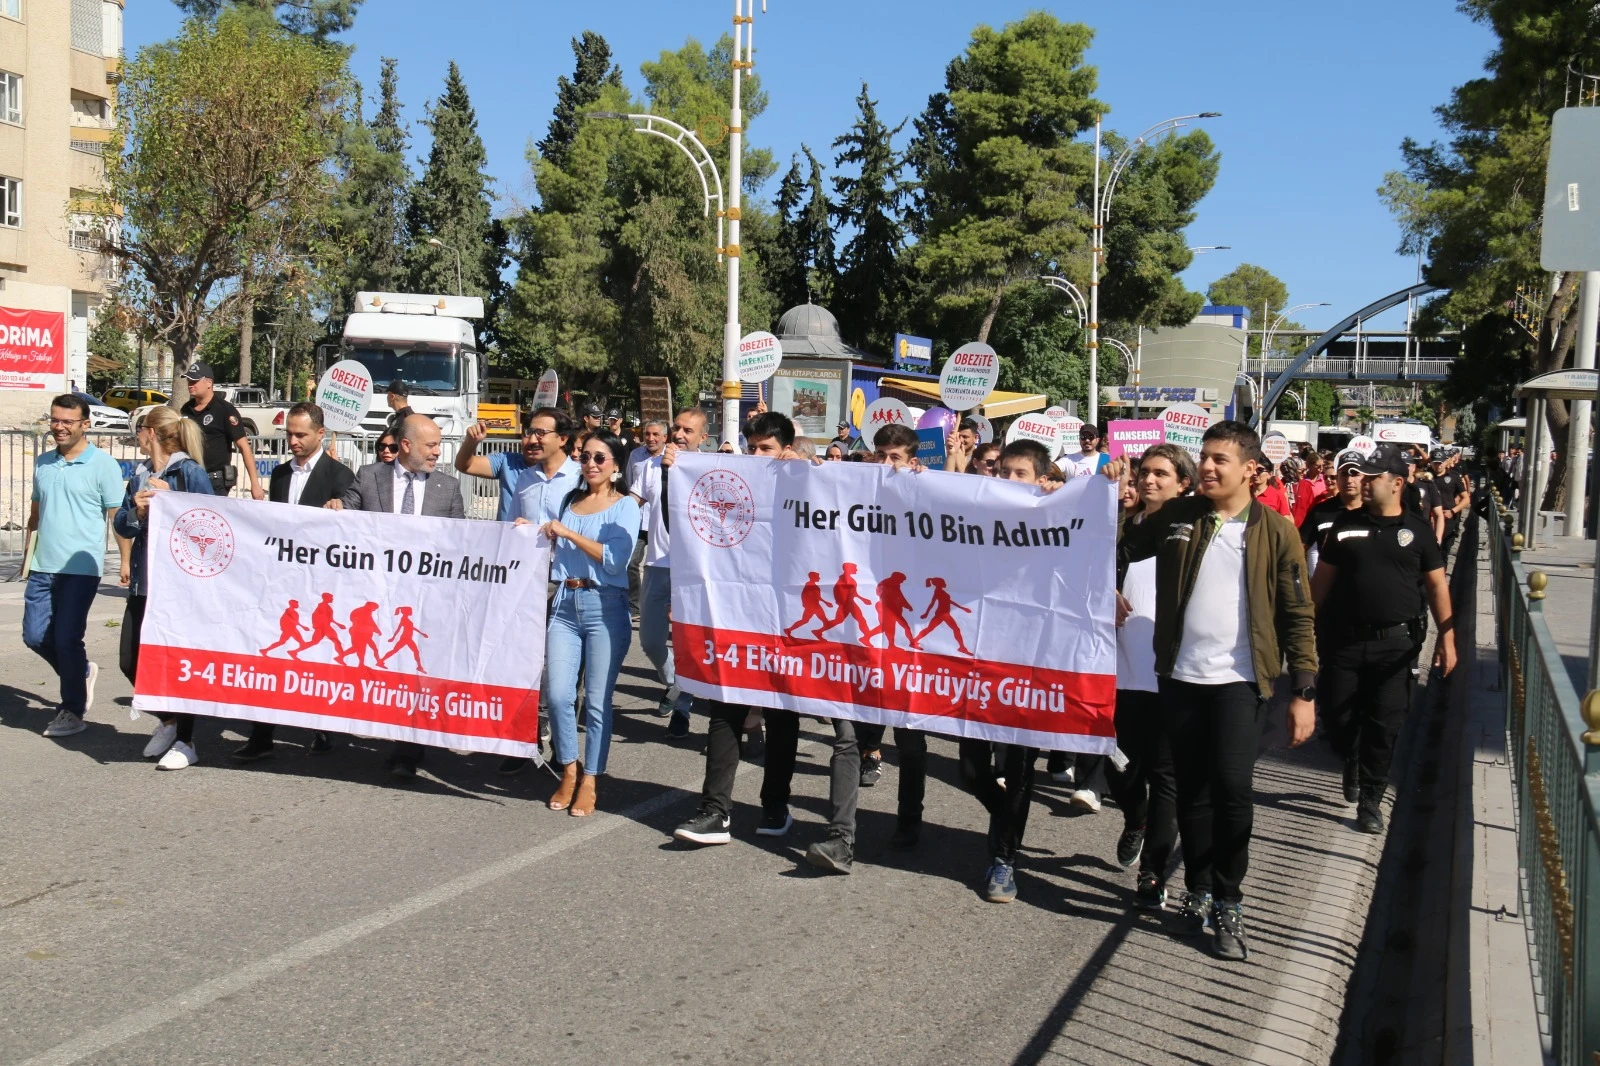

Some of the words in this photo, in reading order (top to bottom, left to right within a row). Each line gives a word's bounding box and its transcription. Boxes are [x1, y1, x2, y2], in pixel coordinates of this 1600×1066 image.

[739, 337, 774, 352] OBEZİTE
[738, 353, 775, 368] HAREKETE
[954, 353, 994, 367] OBEZİTE
[331, 367, 369, 392] OBEZİTE
[792, 369, 837, 379] KİTAPÇILARDA
[946, 374, 989, 387] HAREKETE
[321, 388, 361, 412] HAREKETE
[1165, 411, 1209, 428] OBEZİTE
[1165, 422, 1180, 430] SAĞLIK
[1018, 420, 1057, 438] OBEZİTE
[1113, 428, 1161, 441] KANSERSİZ
[1165, 431, 1204, 445] AREKETE
[847, 503, 897, 536] Gün
[904, 511, 934, 540] 10
[940, 513, 985, 546] Bin
[325, 543, 375, 571] Gün
[383, 549, 413, 574] 10
[417, 551, 452, 579] Bin
[702, 639, 739, 668] 3-4
[745, 644, 803, 678] Ekim
[809, 651, 885, 694] Dünya
[891, 662, 992, 709] Yürüyüş
[996, 676, 1066, 713] Günü
[177, 659, 217, 686] 3-4
[222, 663, 278, 694] Ekim
[283, 669, 355, 706] Dünya
[360, 678, 441, 720] Yürüyüş
[444, 691, 504, 722] Günü
